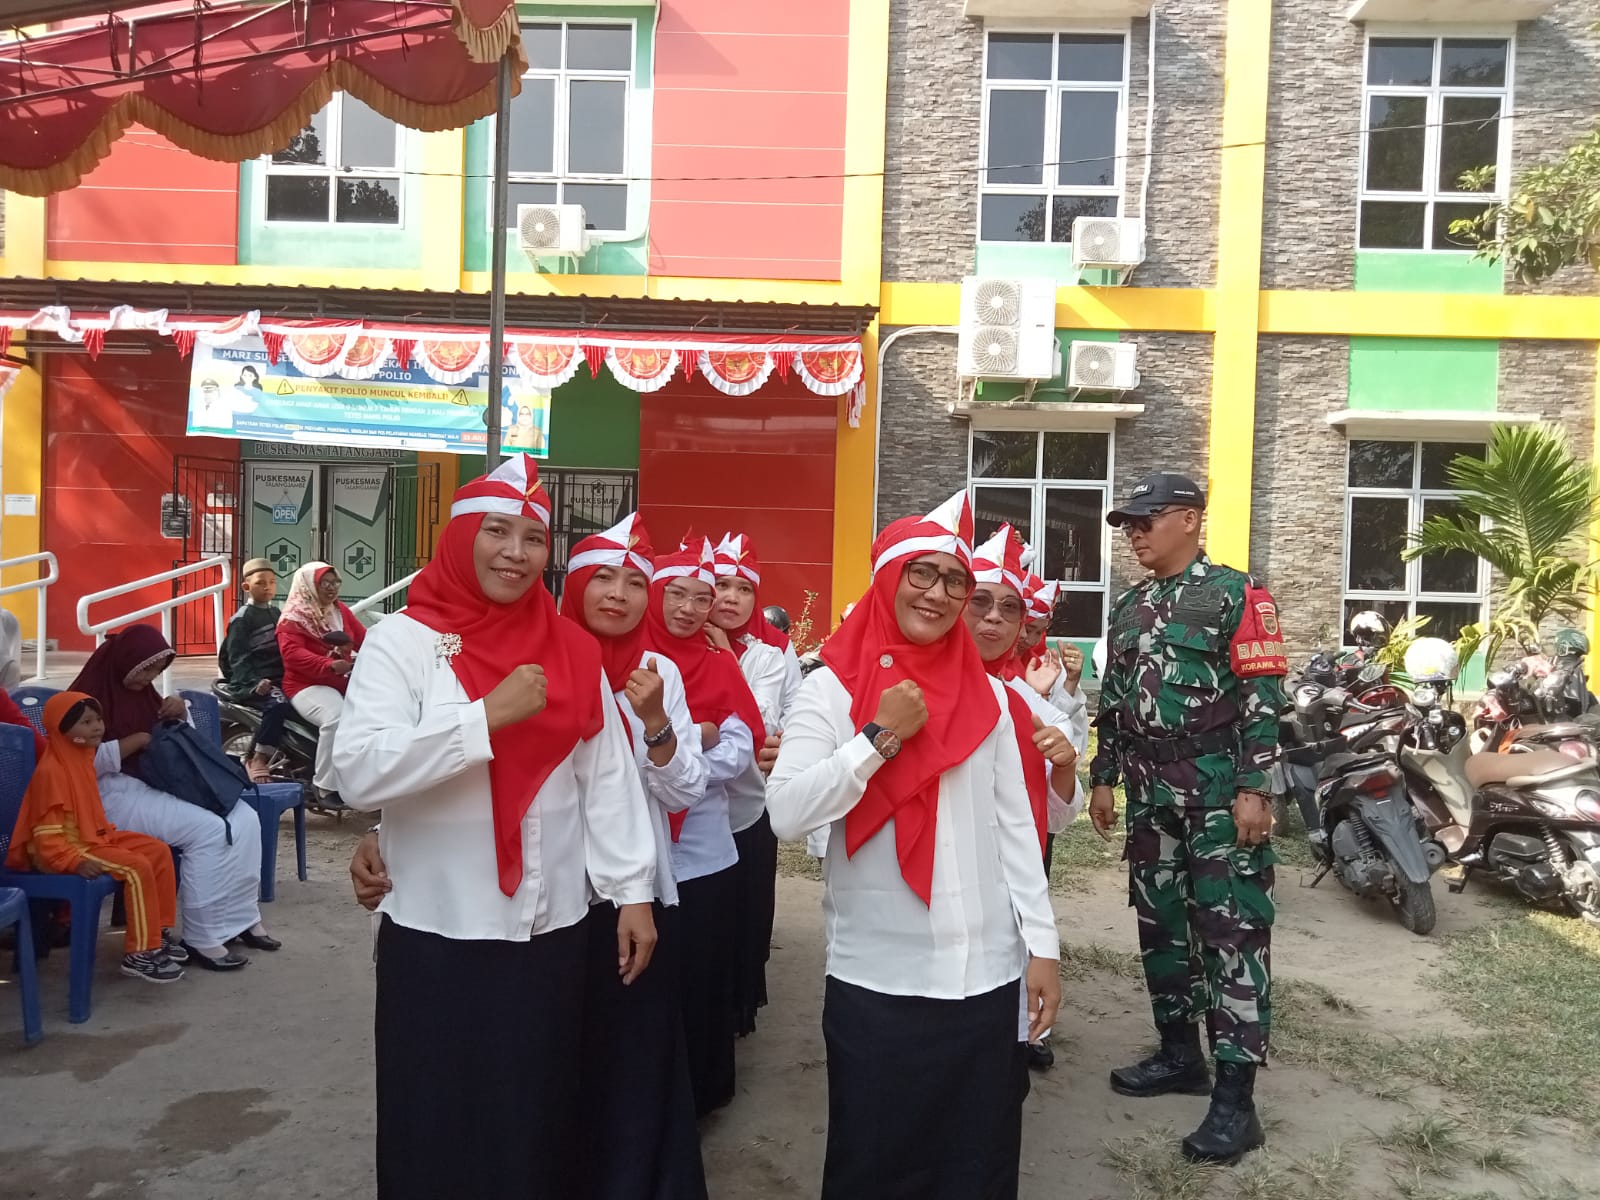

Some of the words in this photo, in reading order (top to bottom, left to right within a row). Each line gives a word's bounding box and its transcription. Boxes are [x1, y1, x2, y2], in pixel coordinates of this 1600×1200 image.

[222, 350, 252, 360] MARI
[379, 371, 412, 381] POLIO
[295, 384, 339, 394] PENYAKIT
[341, 387, 367, 396] POLIO
[370, 389, 407, 399] MUNCUL
[408, 391, 449, 401] KEMBALI!
[254, 442, 323, 456] PUSKESMAS
[255, 474, 307, 484] PUSKESMAS
[335, 477, 381, 486] PUSKESMAS
[274, 509, 296, 520] OPEN
[1240, 661, 1276, 672] KORAMIL
